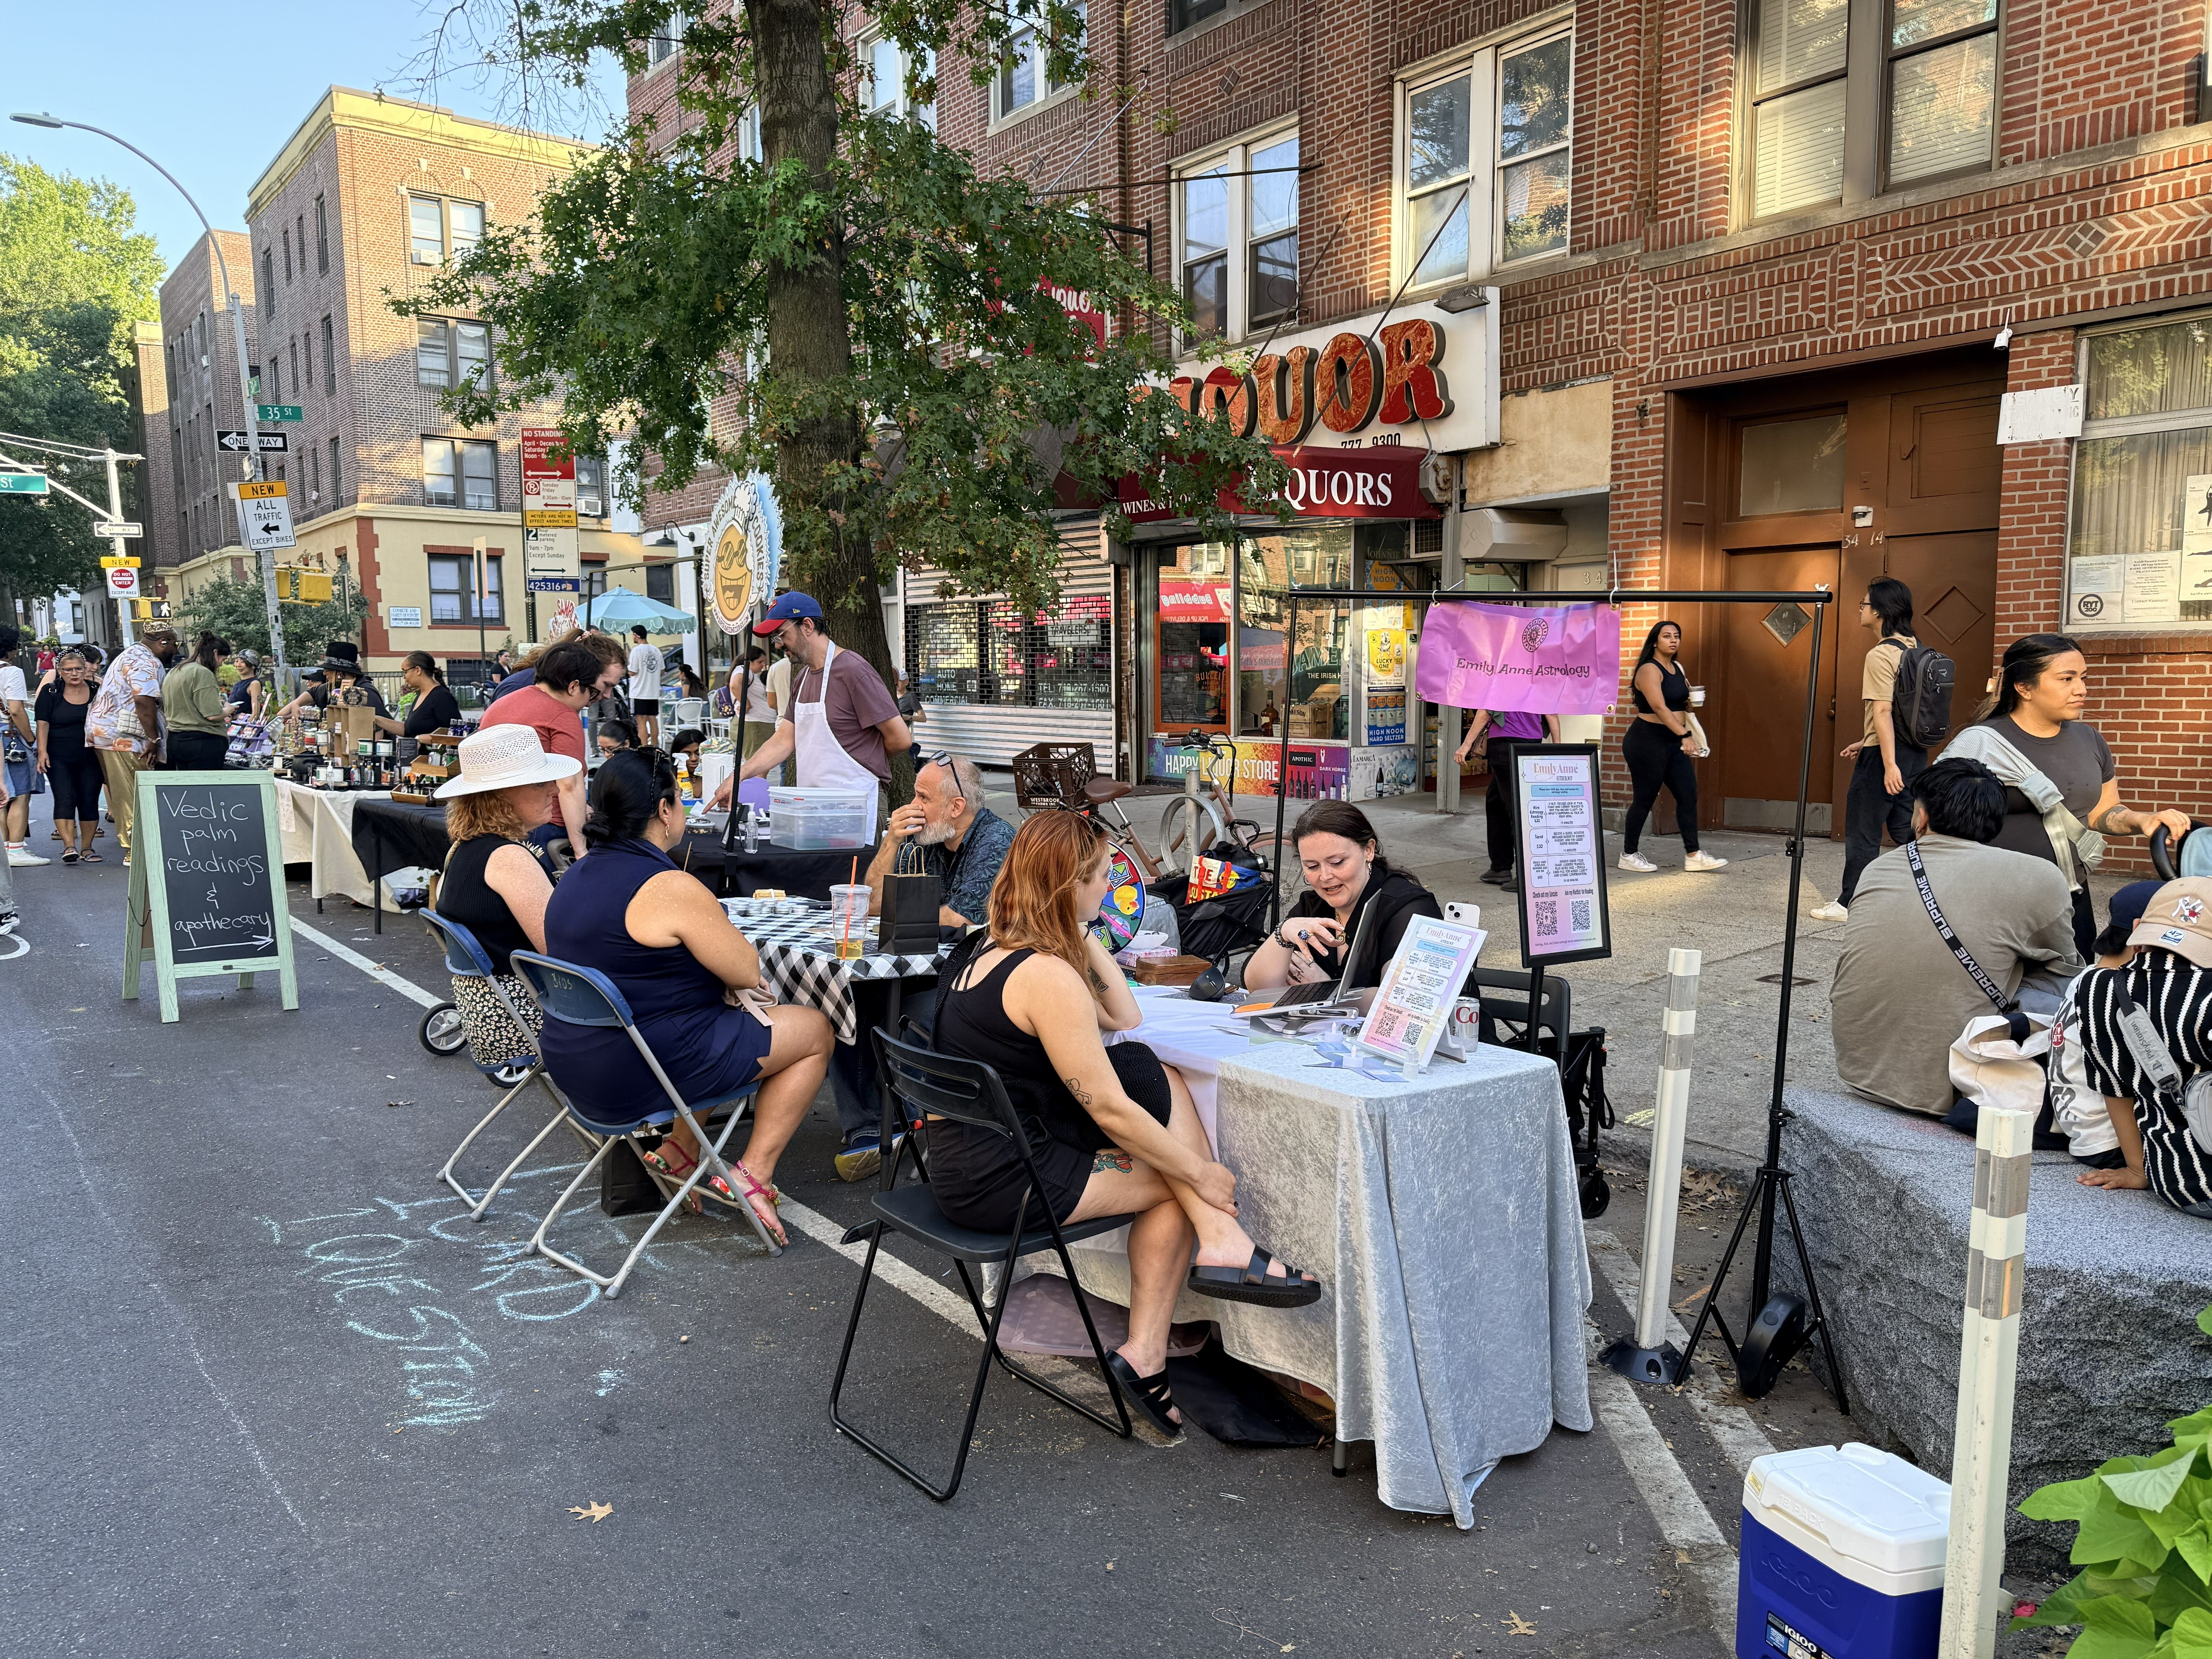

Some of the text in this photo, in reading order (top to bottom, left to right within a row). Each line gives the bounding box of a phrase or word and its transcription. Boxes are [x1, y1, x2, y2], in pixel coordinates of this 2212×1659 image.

[1128, 318, 1455, 445] IQUOR
[267, 407, 292, 419] 35 St
[228, 437, 278, 446] ONE WAY
[0, 477, 14, 488] St
[252, 484, 274, 496] NEW
[1247, 466, 1392, 510] QUORS
[256, 500, 276, 510] ALL
[1123, 499, 1155, 515] WINES
[1158, 498, 1166, 510] &
[254, 512, 282, 521] TRAFFIC
[252, 537, 273, 545] EXCEPT
[528, 528, 537, 540] 2
[1842, 534, 1859, 548] 34
[704, 537, 713, 580] SUPER
[529, 582, 561, 591] 425316
[1051, 625, 1087, 635] TRAVELERS
[1293, 644, 1341, 675] JAME
[1456, 658, 1590, 678] Emily Anne Astrology
[937, 669, 955, 678] AUTO
[937, 682, 957, 691] HOME
[925, 695, 969, 704] COMMERCIAL
[1290, 709, 1306, 718] MESON
[1165, 754, 1199, 774] HAPPY
[1243, 759, 1279, 781] STORE
[162, 790, 248, 822] Vedic
[180, 823, 237, 855] palm
[167, 850, 264, 886] readings
[1194, 866, 1213, 882] TE
[207, 882, 219, 910] &
[1917, 875, 1954, 940] SUPREME
[175, 911, 271, 947] apothecary
[1954, 946, 2008, 1009] SUPREME
[1456, 1006, 1479, 1024] Co
[1793, 1505, 1826, 1529] PACK
[1784, 1625, 1817, 1653] IGLOO
